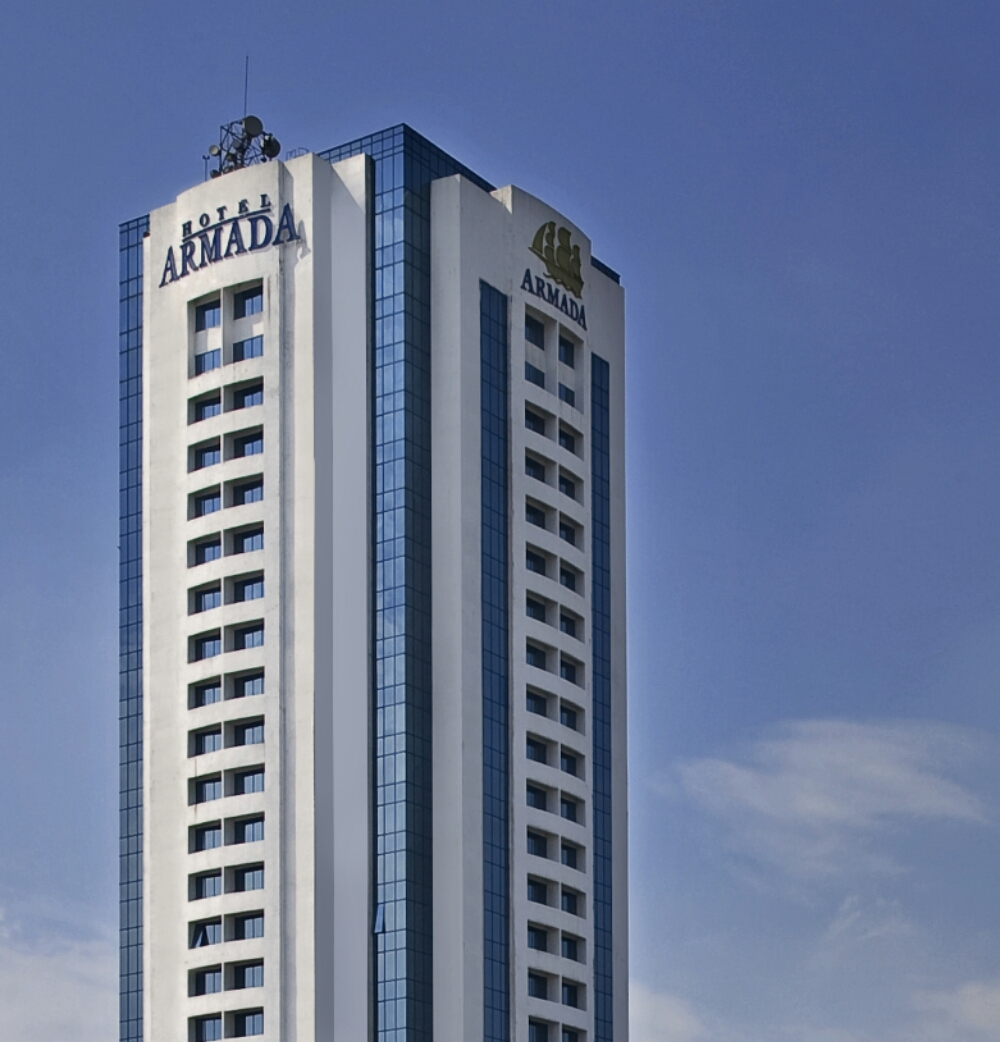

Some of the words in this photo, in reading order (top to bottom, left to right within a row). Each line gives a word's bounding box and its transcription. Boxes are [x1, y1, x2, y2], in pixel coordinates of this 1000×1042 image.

[158, 202, 301, 288] ARMADA
[181, 193, 271, 237] HOTEL
[520, 268, 587, 331] ARMADA
